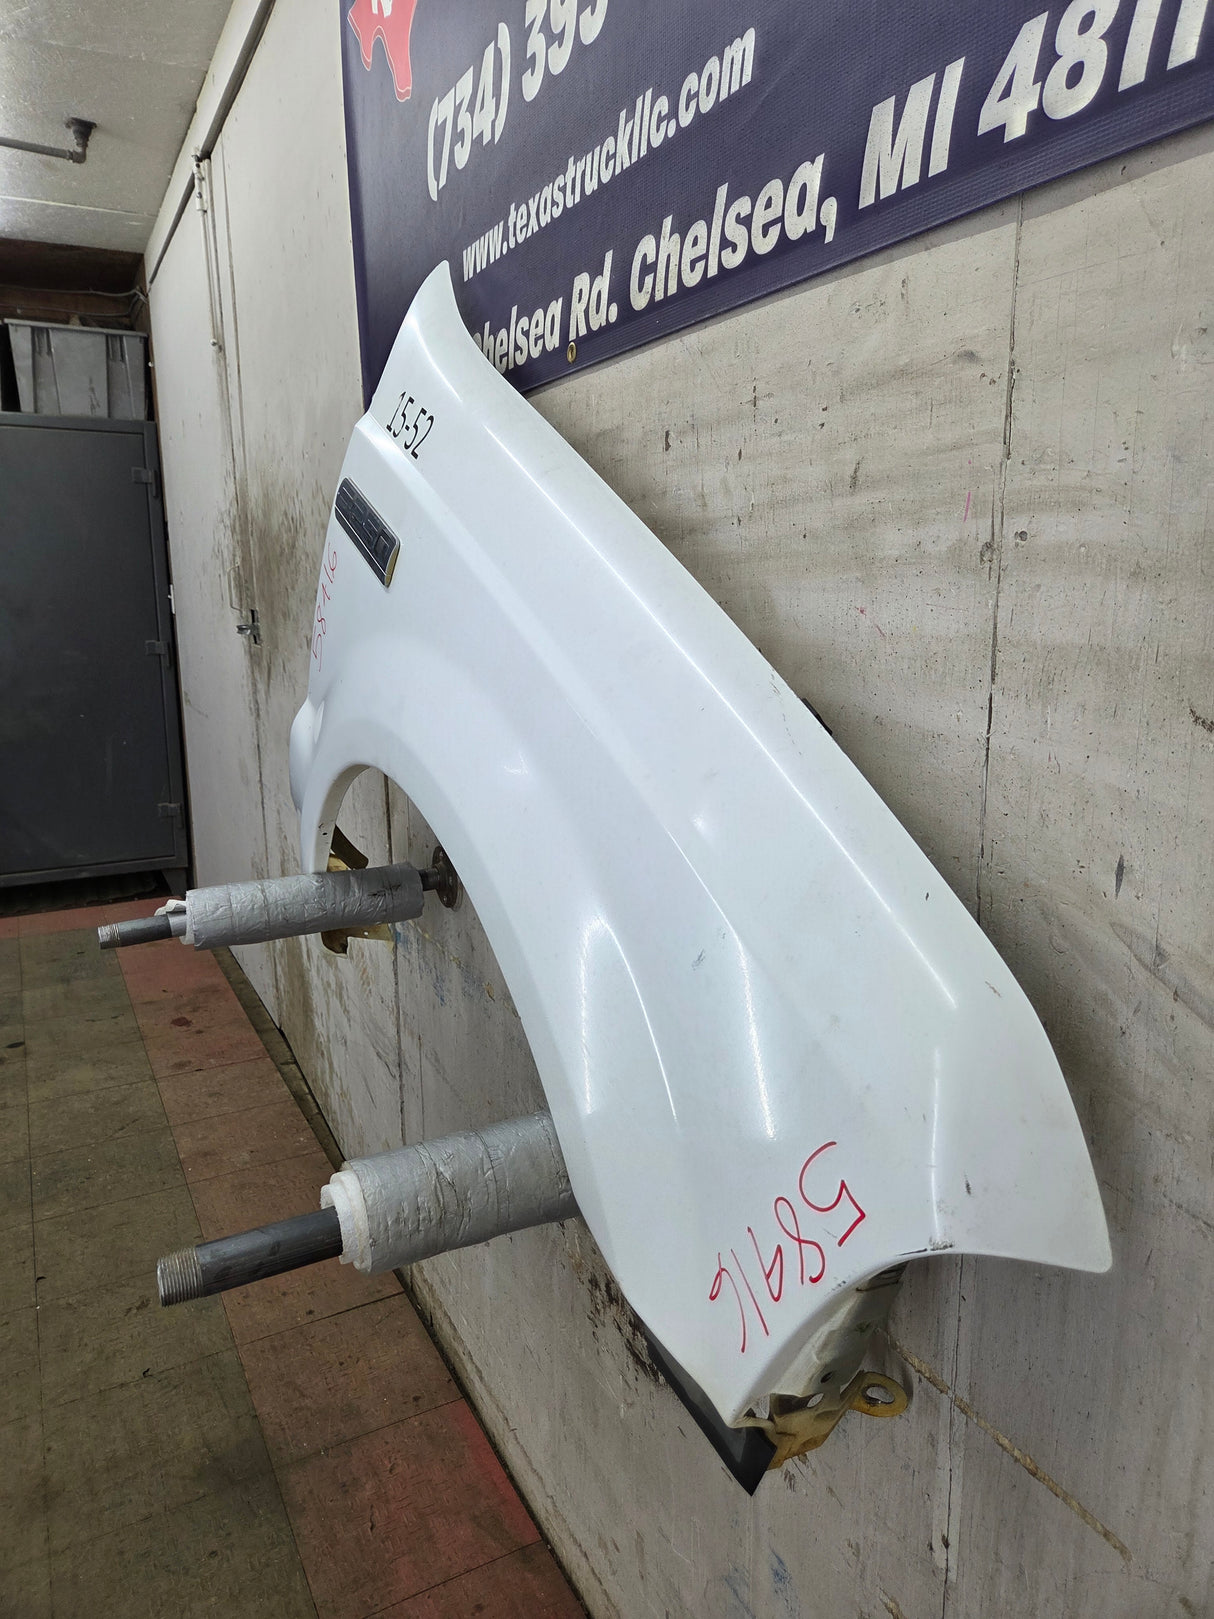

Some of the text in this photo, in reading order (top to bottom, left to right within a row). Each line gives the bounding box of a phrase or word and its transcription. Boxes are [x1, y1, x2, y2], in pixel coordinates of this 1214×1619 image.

[428, 22, 510, 201] (734)
[462, 27, 756, 282] www.texastruckllc.com
[569, 249, 618, 342] Rd.
[629, 153, 838, 311] Chelsea,
[858, 57, 965, 210] MI
[386, 391, 435, 459] 15-52
